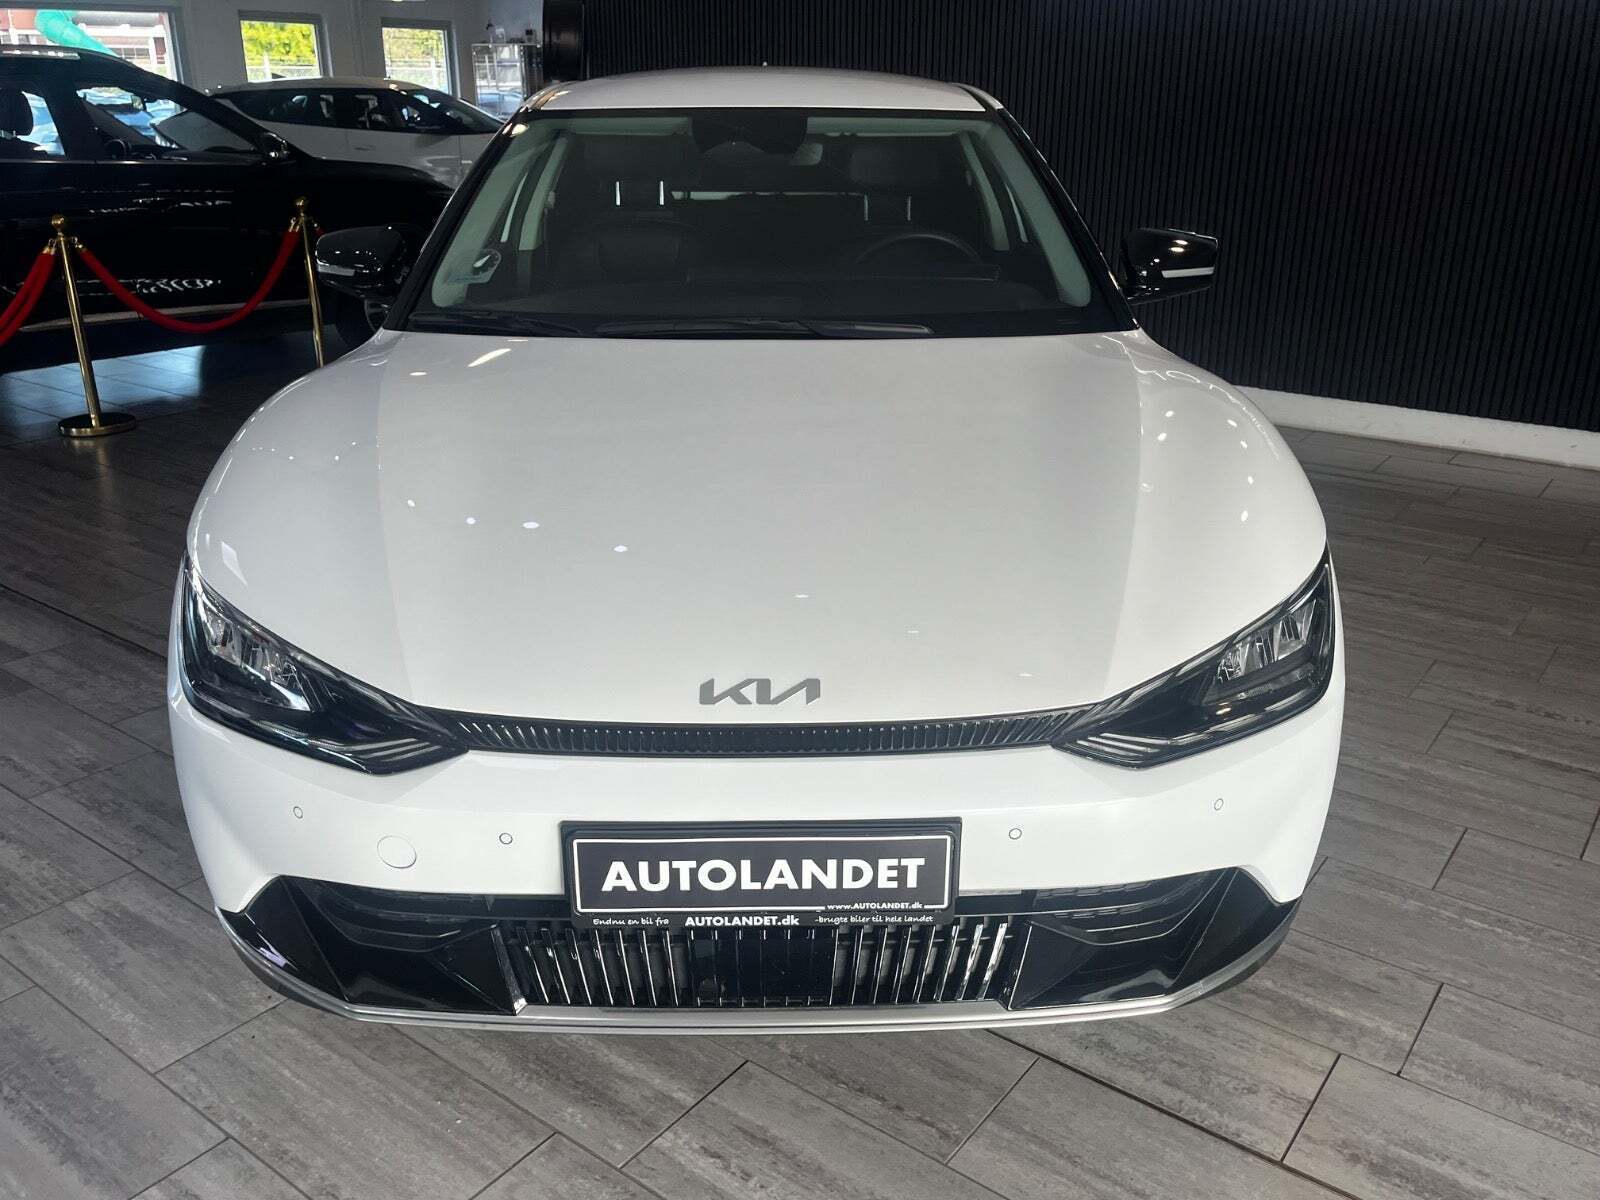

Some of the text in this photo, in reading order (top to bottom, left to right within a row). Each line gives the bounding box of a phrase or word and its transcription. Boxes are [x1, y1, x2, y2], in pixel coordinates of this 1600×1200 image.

[601, 858, 926, 892] AUTOLANDET
[827, 902, 923, 910] www.AUTOLANDET.dk
[641, 917, 654, 925] bil
[685, 915, 800, 926] AUTOLANDET.dk
